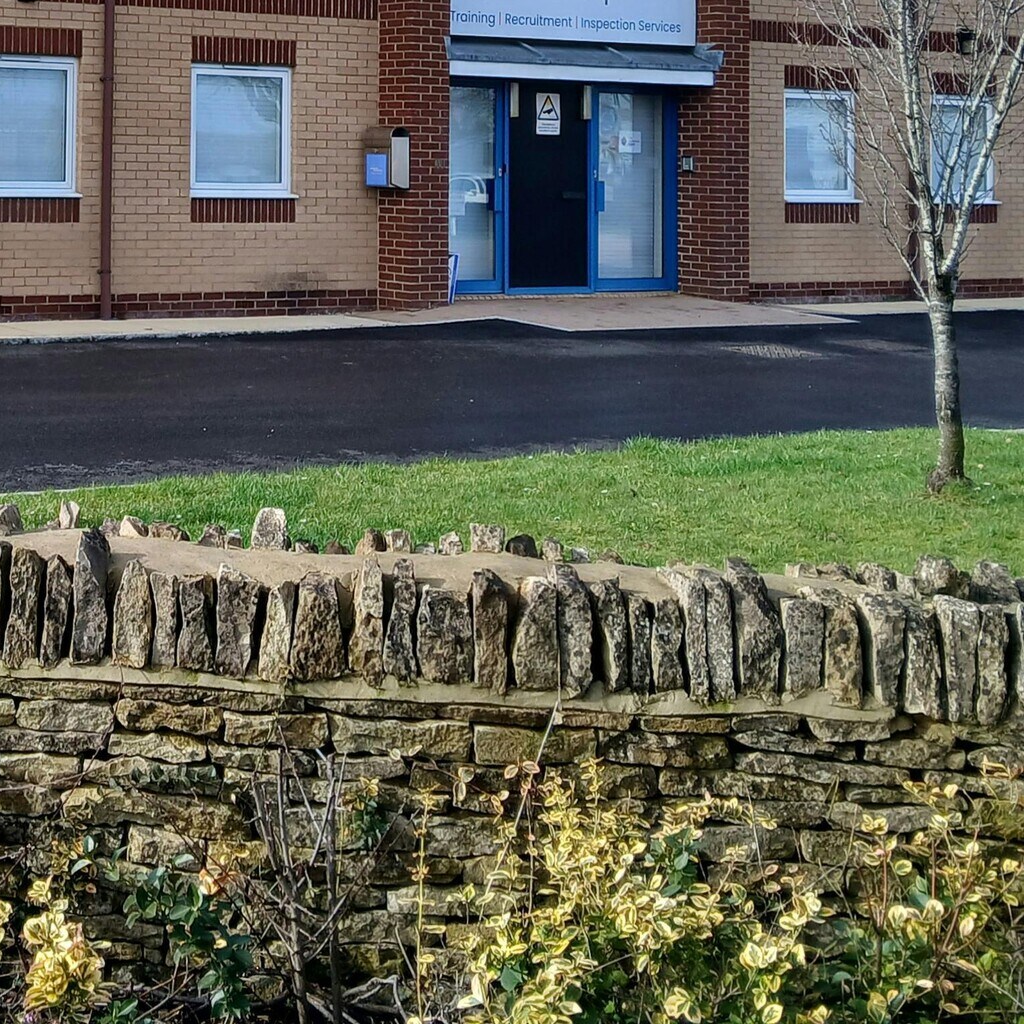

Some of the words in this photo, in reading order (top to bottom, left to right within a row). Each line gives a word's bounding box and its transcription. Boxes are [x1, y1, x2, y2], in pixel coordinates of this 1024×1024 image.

[450, 10, 496, 28] Training
[504, 12, 573, 28] Recruitment
[580, 17, 636, 32] Inspection
[638, 19, 682, 33] Services
